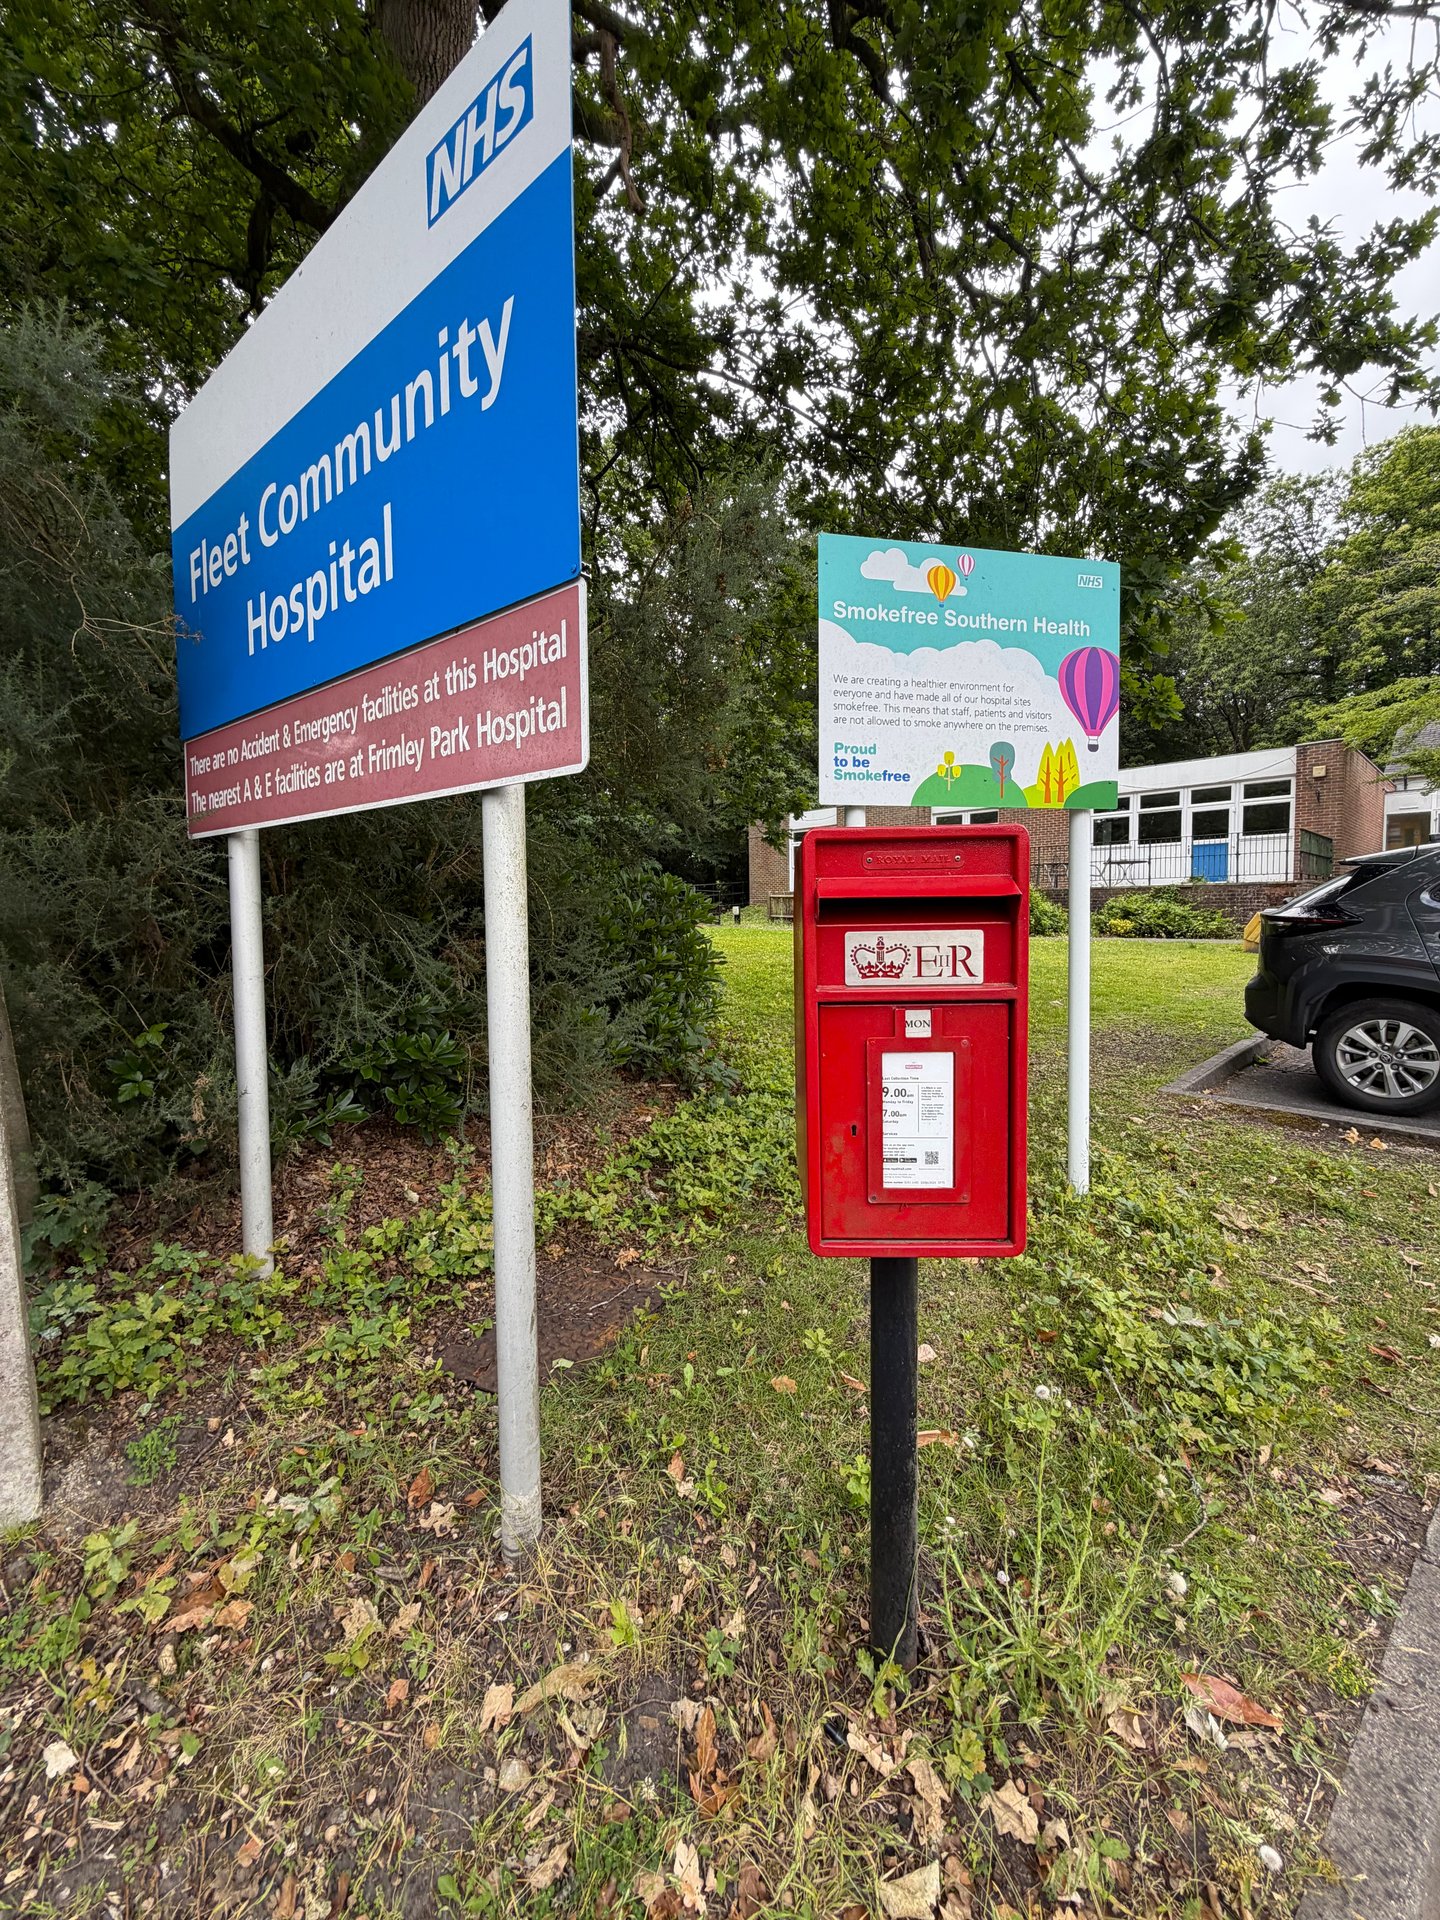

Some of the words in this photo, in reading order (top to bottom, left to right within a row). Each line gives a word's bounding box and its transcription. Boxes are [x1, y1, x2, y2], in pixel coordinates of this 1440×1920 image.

[430, 46, 529, 221] NHS
[189, 512, 251, 603] Fleet
[258, 295, 515, 548] Community
[246, 502, 395, 657] Hospital
[1078, 575, 1102, 588] NHS
[833, 600, 938, 625] Smokefree
[944, 610, 1028, 632] Southern
[1033, 617, 1090, 637] Health
[833, 674, 848, 684] We
[866, 678, 901, 688] creating
[911, 678, 947, 688] healthier
[950, 682, 1000, 692] environment
[1002, 683, 1014, 693] for
[190, 755, 211, 777] There
[212, 753, 226, 770] are
[228, 747, 238, 766] no
[241, 729, 280, 762] Accident
[282, 724, 292, 748] &
[294, 705, 358, 745] Emergency
[362, 682, 418, 723] facilities
[424, 671, 440, 704] at
[445, 657, 476, 696] this
[484, 619, 567, 684] Hospital
[833, 689, 872, 700] everyone
[874, 690, 891, 700] and
[894, 690, 914, 700] have
[916, 693, 940, 702] made
[942, 694, 951, 702] all
[953, 694, 962, 703] of
[980, 695, 1012, 706] hospital
[1014, 697, 1032, 706] sites
[833, 702, 880, 712] smokefree.
[884, 703, 900, 713] This
[932, 706, 950, 716] that
[952, 707, 972, 718] staff,
[974, 708, 1006, 718] patients
[1008, 710, 1024, 719] and
[1026, 710, 1052, 720] visitors
[833, 716, 847, 724] are
[850, 716, 864, 726] not
[866, 716, 900, 726] allowed
[903, 718, 912, 727] to
[914, 718, 942, 728] smoke
[944, 720, 983, 730] anywhere
[986, 722, 996, 730] on
[998, 722, 1012, 730] the
[1014, 724, 1050, 732] premises.
[192, 790, 206, 814] The
[208, 781, 241, 810] nearest
[244, 778, 252, 802] A
[254, 775, 262, 800] &
[265, 772, 272, 798] E
[275, 762, 321, 795] facilities
[324, 759, 345, 785] are
[350, 749, 364, 778] at
[368, 734, 424, 773] Frimley
[430, 716, 470, 759] Park
[476, 686, 567, 749] Hospital
[834, 742, 876, 755] Proud
[834, 757, 848, 768] to
[852, 756, 870, 768] be
[834, 768, 910, 782] Smokefree
[876, 855, 915, 864] ROYAL
[921, 854, 951, 864] MAIL
[905, 1020, 930, 1028] MON
